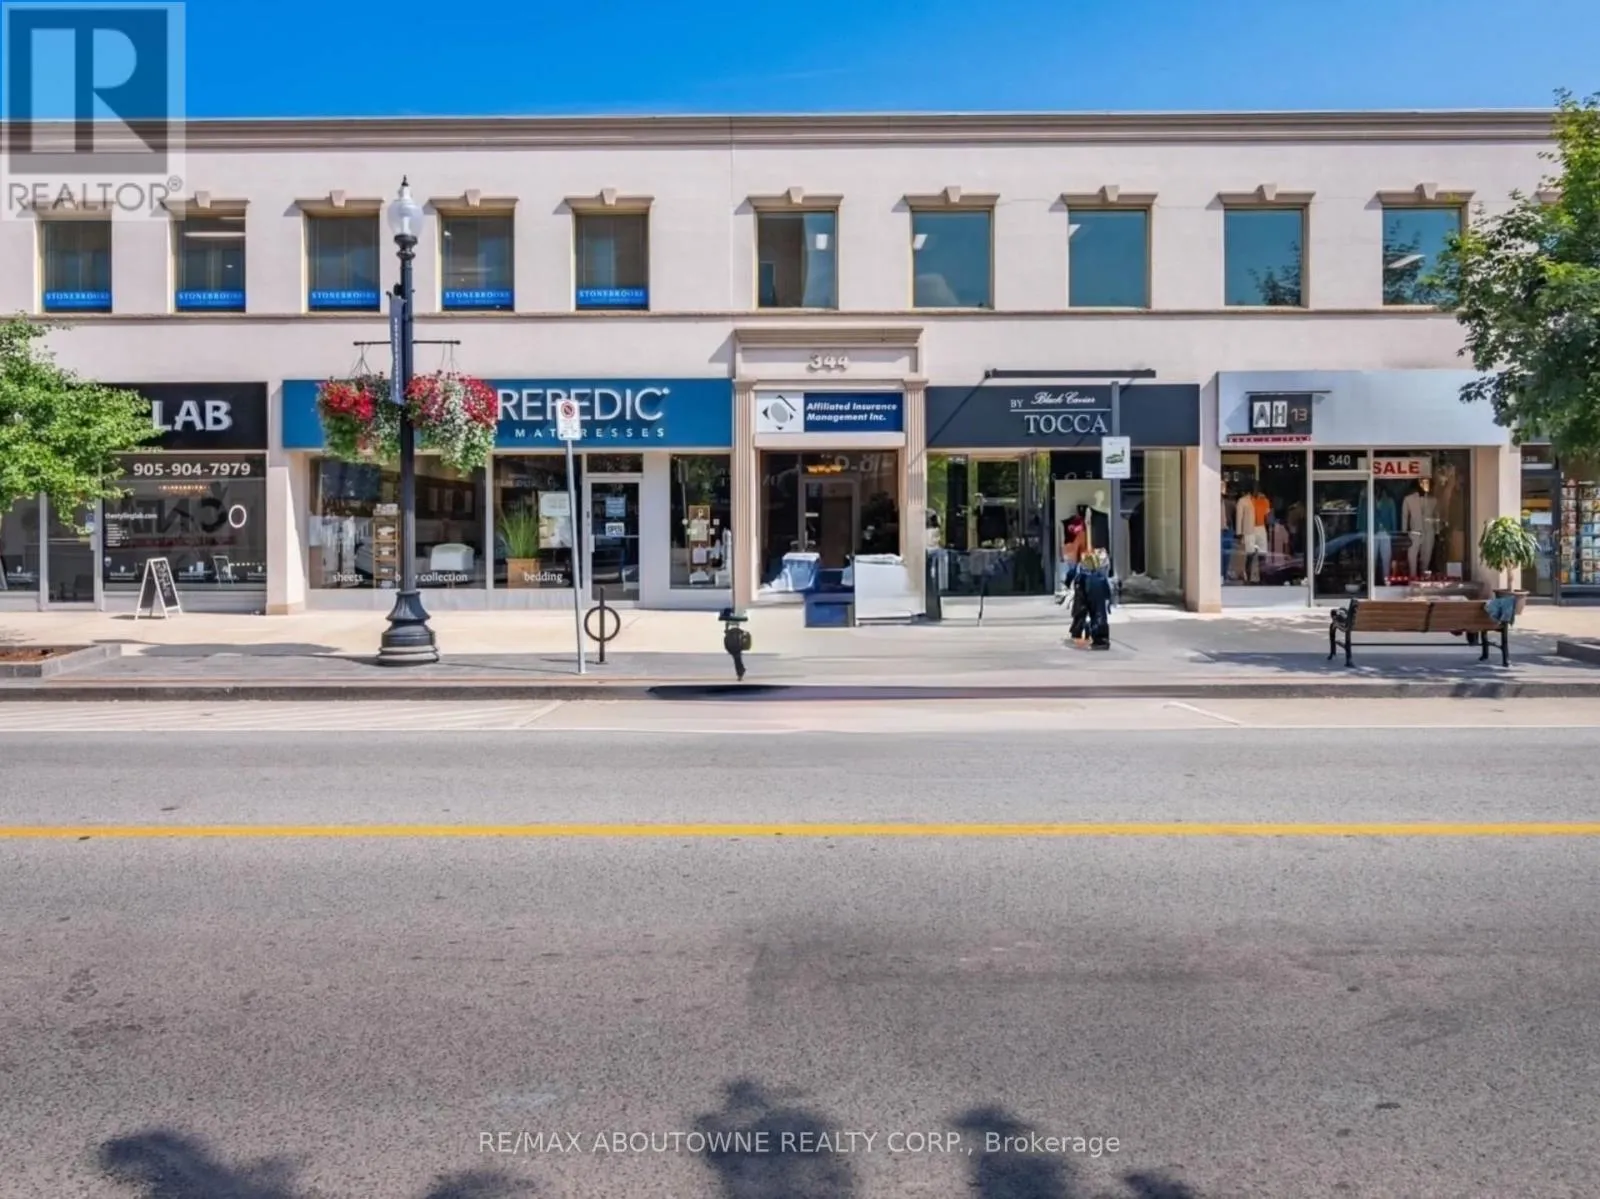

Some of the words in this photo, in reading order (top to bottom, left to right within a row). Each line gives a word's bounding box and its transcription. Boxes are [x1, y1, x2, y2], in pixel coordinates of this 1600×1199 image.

[808, 354, 849, 371] 344
[806, 402, 851, 411] Affiliated
[853, 402, 898, 411] Insurance
[1010, 399, 1024, 408] BY
[152, 400, 232, 431] LAB
[806, 413, 867, 423] Management
[870, 413, 887, 421] Inc.
[1024, 414, 1108, 433] TOCCA
[515, 428, 665, 437] MATRESSES
[1329, 455, 1351, 466] 340
[133, 463, 251, 476] 905-904-7979
[1373, 461, 1420, 475] SALE
[421, 572, 468, 582] collection
[524, 572, 563, 583] bedding
